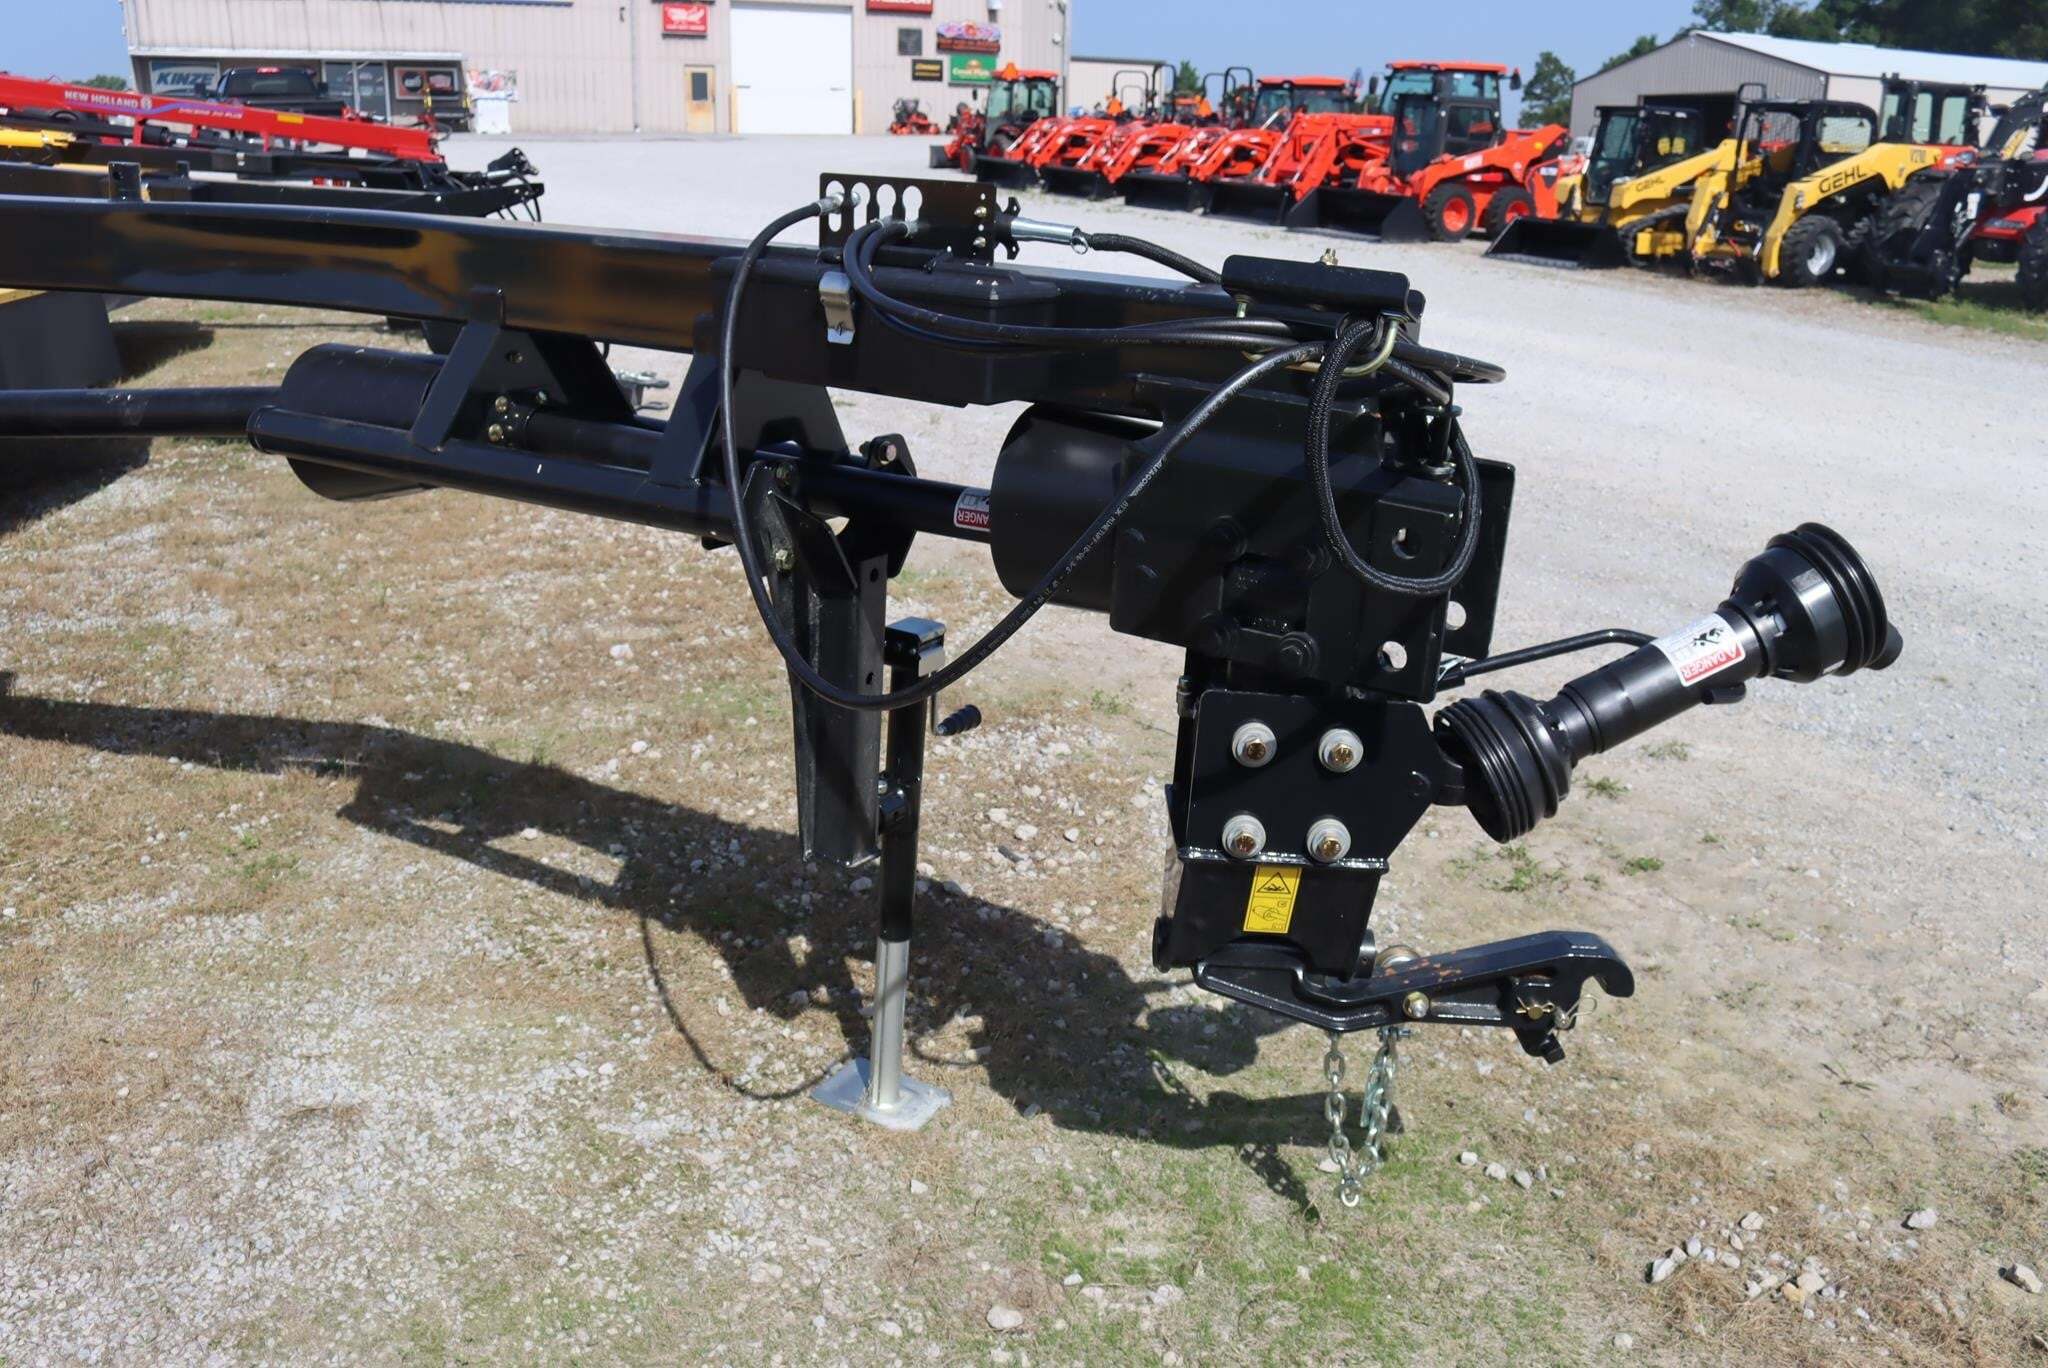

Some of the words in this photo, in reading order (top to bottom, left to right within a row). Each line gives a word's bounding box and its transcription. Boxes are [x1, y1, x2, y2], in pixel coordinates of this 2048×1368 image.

[157, 71, 215, 86] KINZE
[64, 90, 89, 101] NEW
[91, 94, 138, 109] HOLLAND
[1636, 176, 1665, 192] GEHL
[1819, 164, 1867, 194] GEHL
[957, 509, 990, 525] ANGER
[1681, 651, 1727, 677] DANGER
